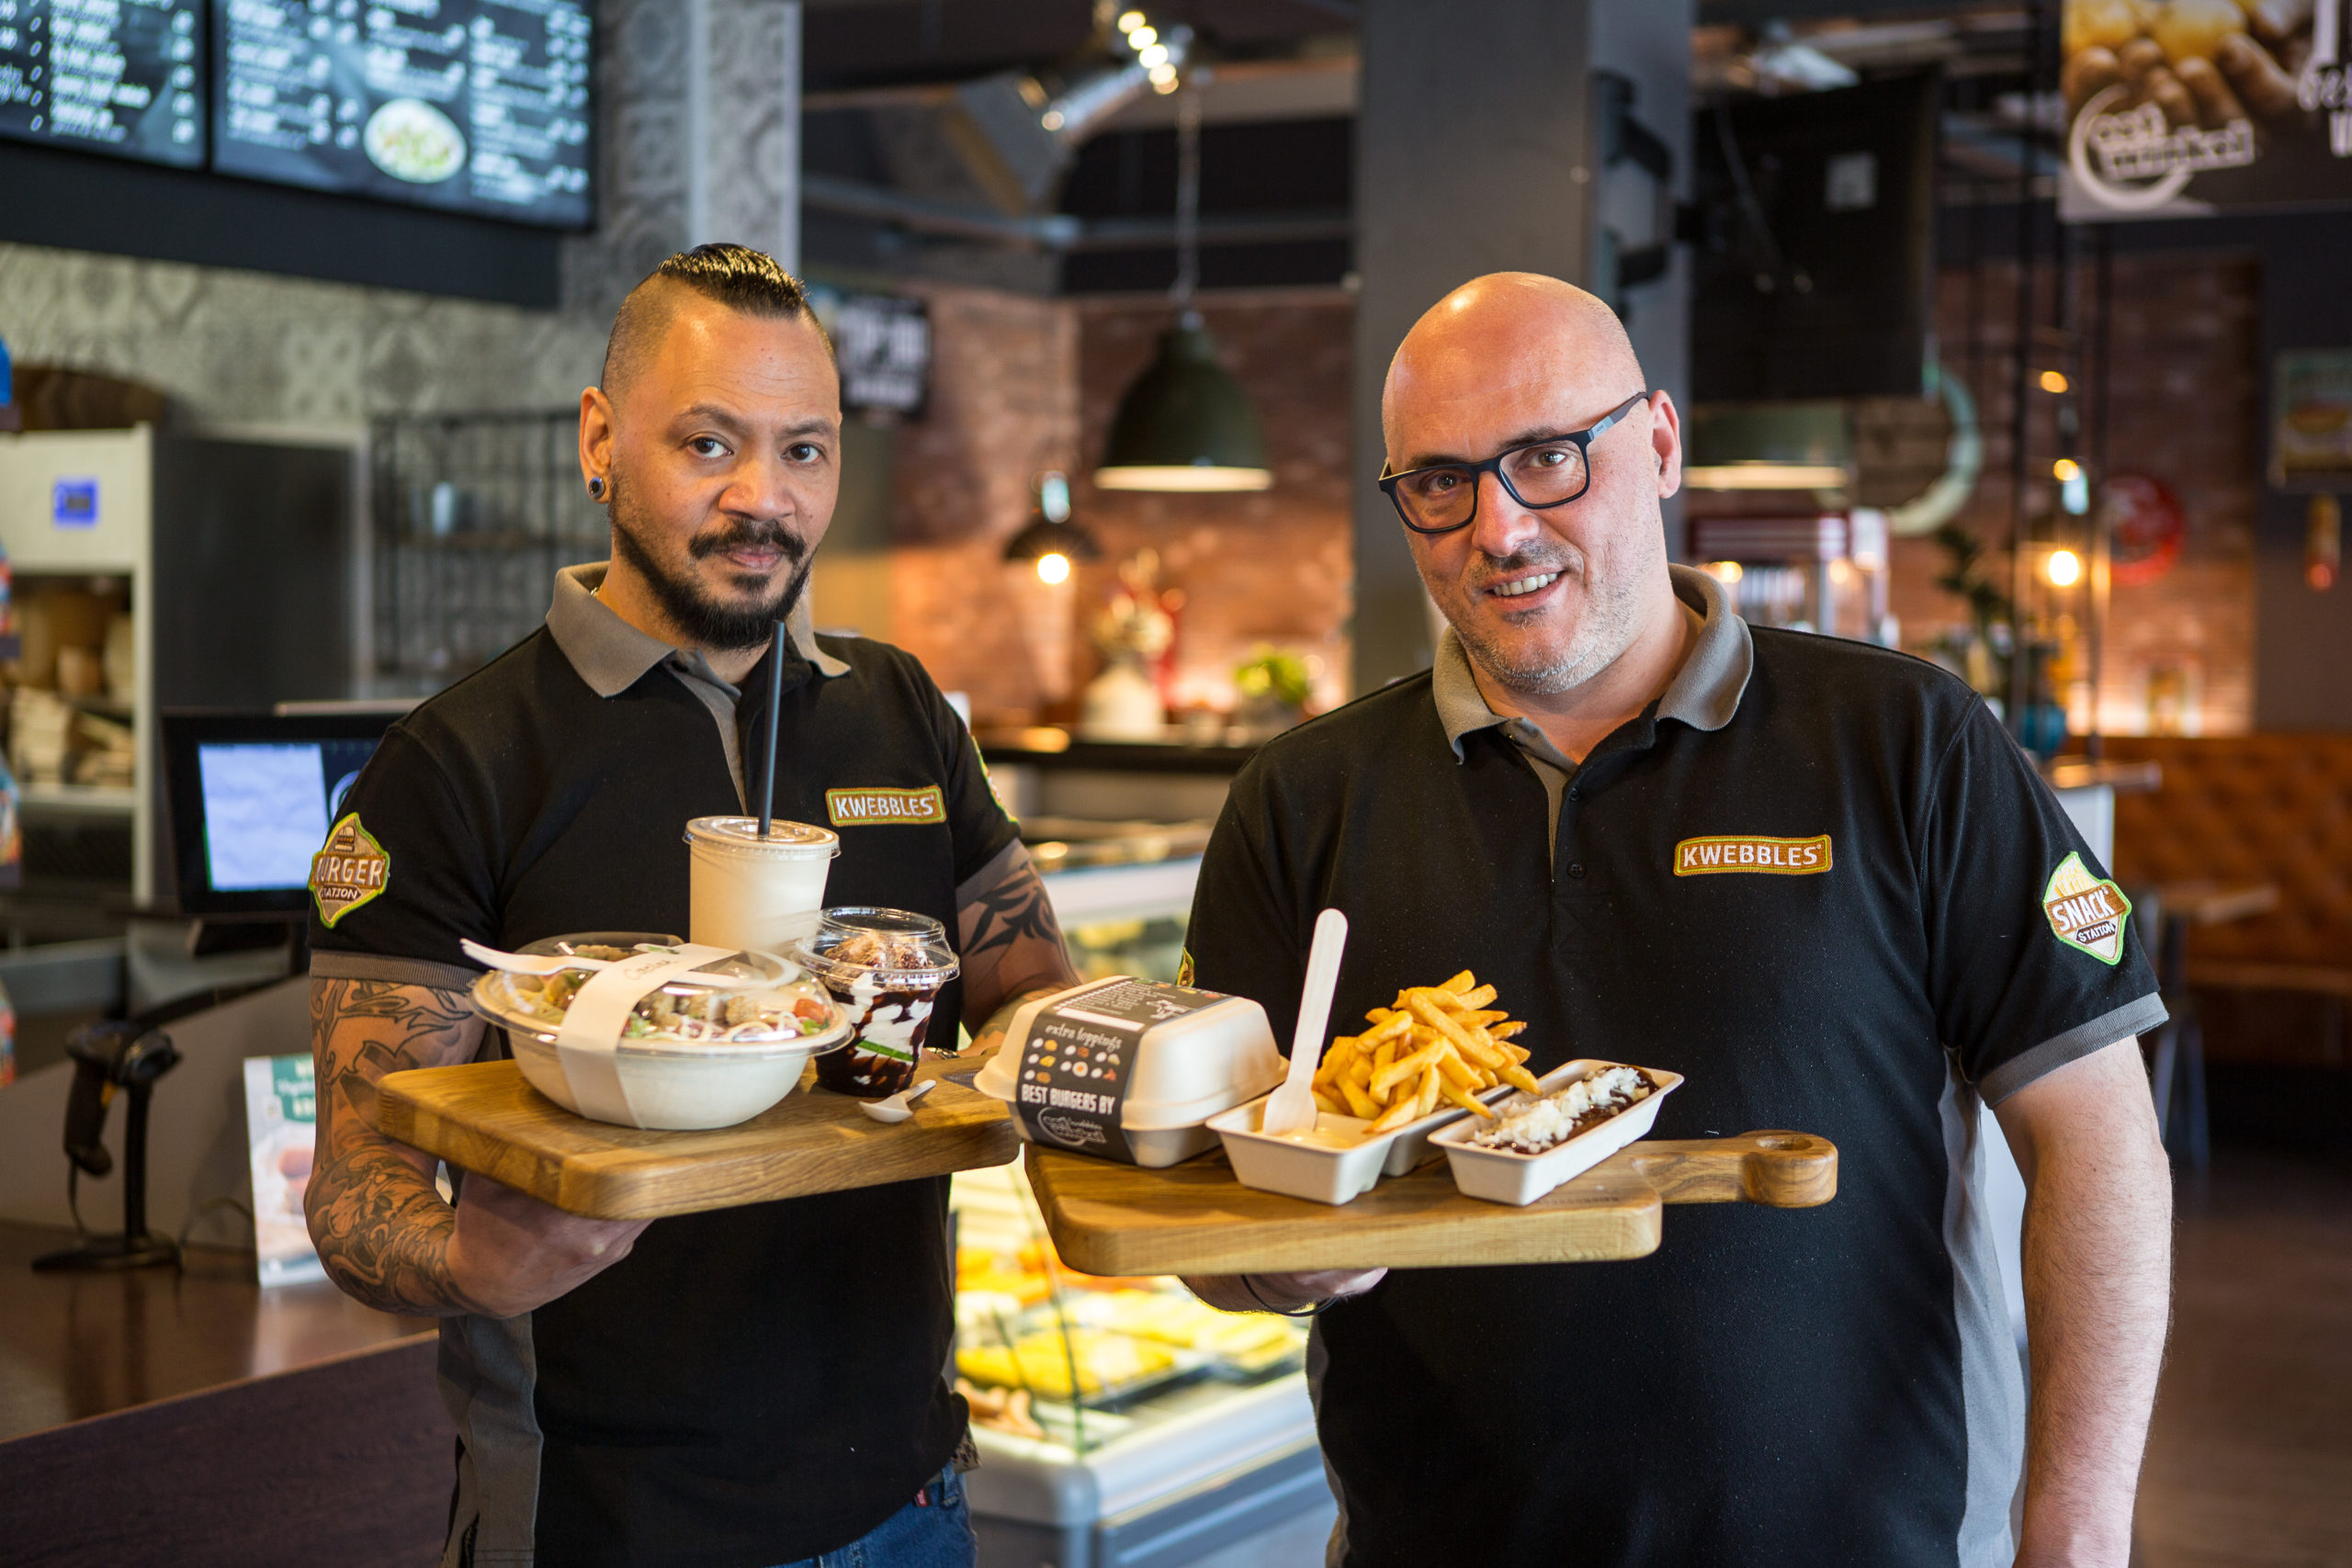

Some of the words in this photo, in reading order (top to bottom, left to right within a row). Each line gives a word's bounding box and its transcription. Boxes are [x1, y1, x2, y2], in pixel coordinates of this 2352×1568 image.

[835, 795, 933, 818] KWEBBLES
[1683, 843, 1819, 867] KWEBBLES
[314, 856, 384, 886] URGER
[321, 887, 357, 899] ATION
[2052, 889, 2115, 931] SNACK
[2077, 922, 2115, 942] STATION
[1045, 1022, 1076, 1039] extra
[1077, 1027, 1123, 1053] toppings
[1021, 1085, 1048, 1104] BEST
[1049, 1088, 1097, 1112] BURGERS
[1098, 1095, 1115, 1115] BY
